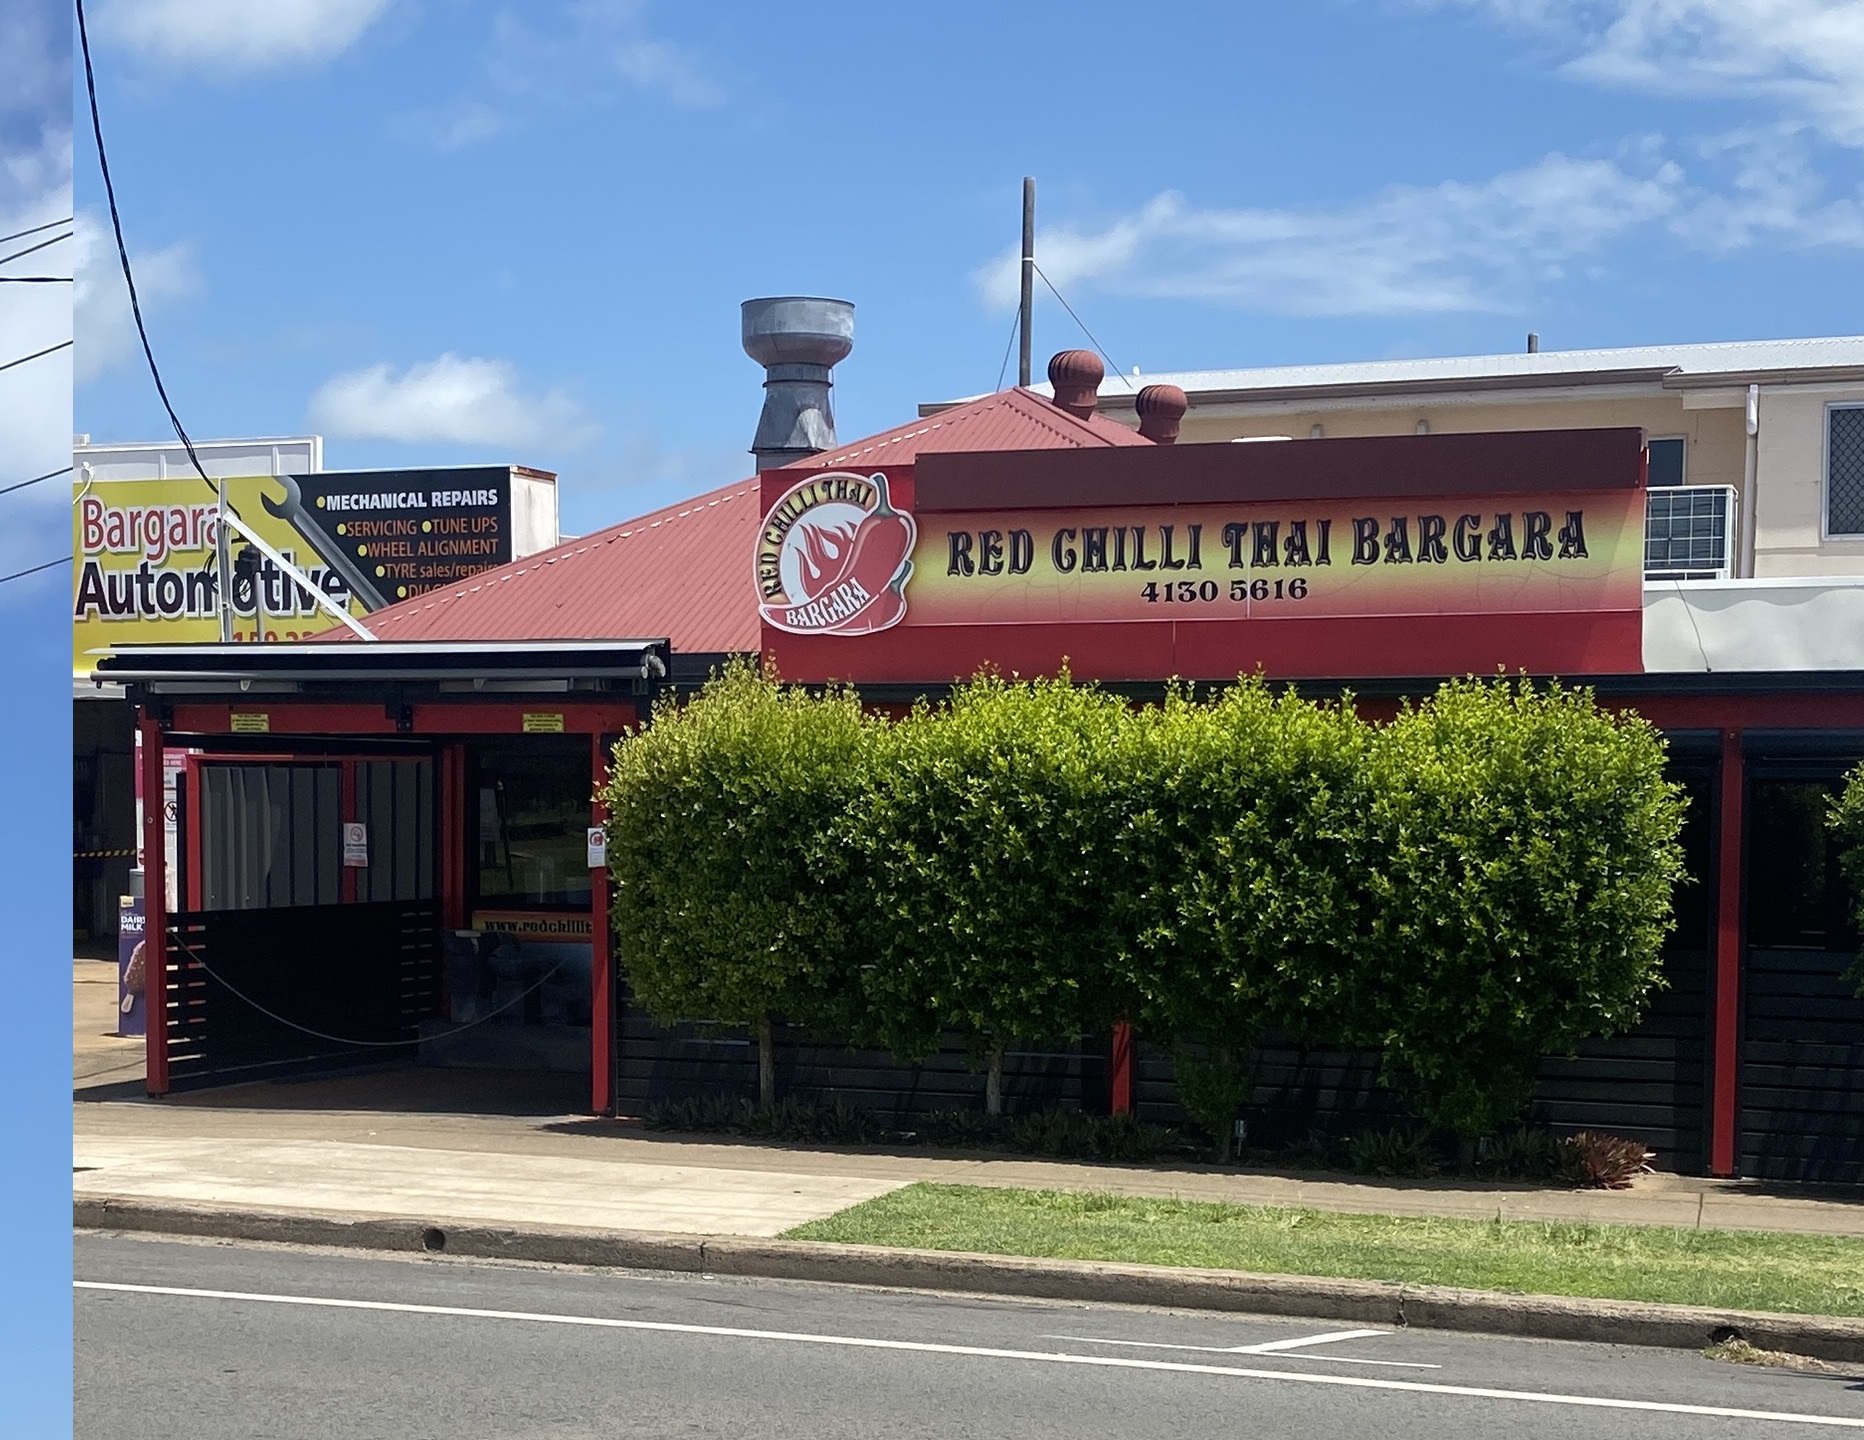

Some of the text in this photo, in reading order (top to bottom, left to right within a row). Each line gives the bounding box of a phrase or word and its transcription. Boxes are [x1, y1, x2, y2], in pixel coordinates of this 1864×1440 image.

[326, 489, 498, 511] MECHANICAL REPAIRS
[82, 498, 219, 562] Bargara
[346, 516, 498, 537] SERVICING TUNE UPS
[760, 479, 873, 598] RED CHILLI THAI
[366, 538, 499, 558] WHEEL ALIGNMENT
[947, 510, 1589, 577] RED CHILLI THAI BARGARA
[385, 562, 417, 579] TYRE
[75, 553, 347, 616] Automotive
[1140, 577, 1308, 603] 4130 5616
[786, 576, 871, 627] BARGARA
[120, 923, 144, 931] MILK
